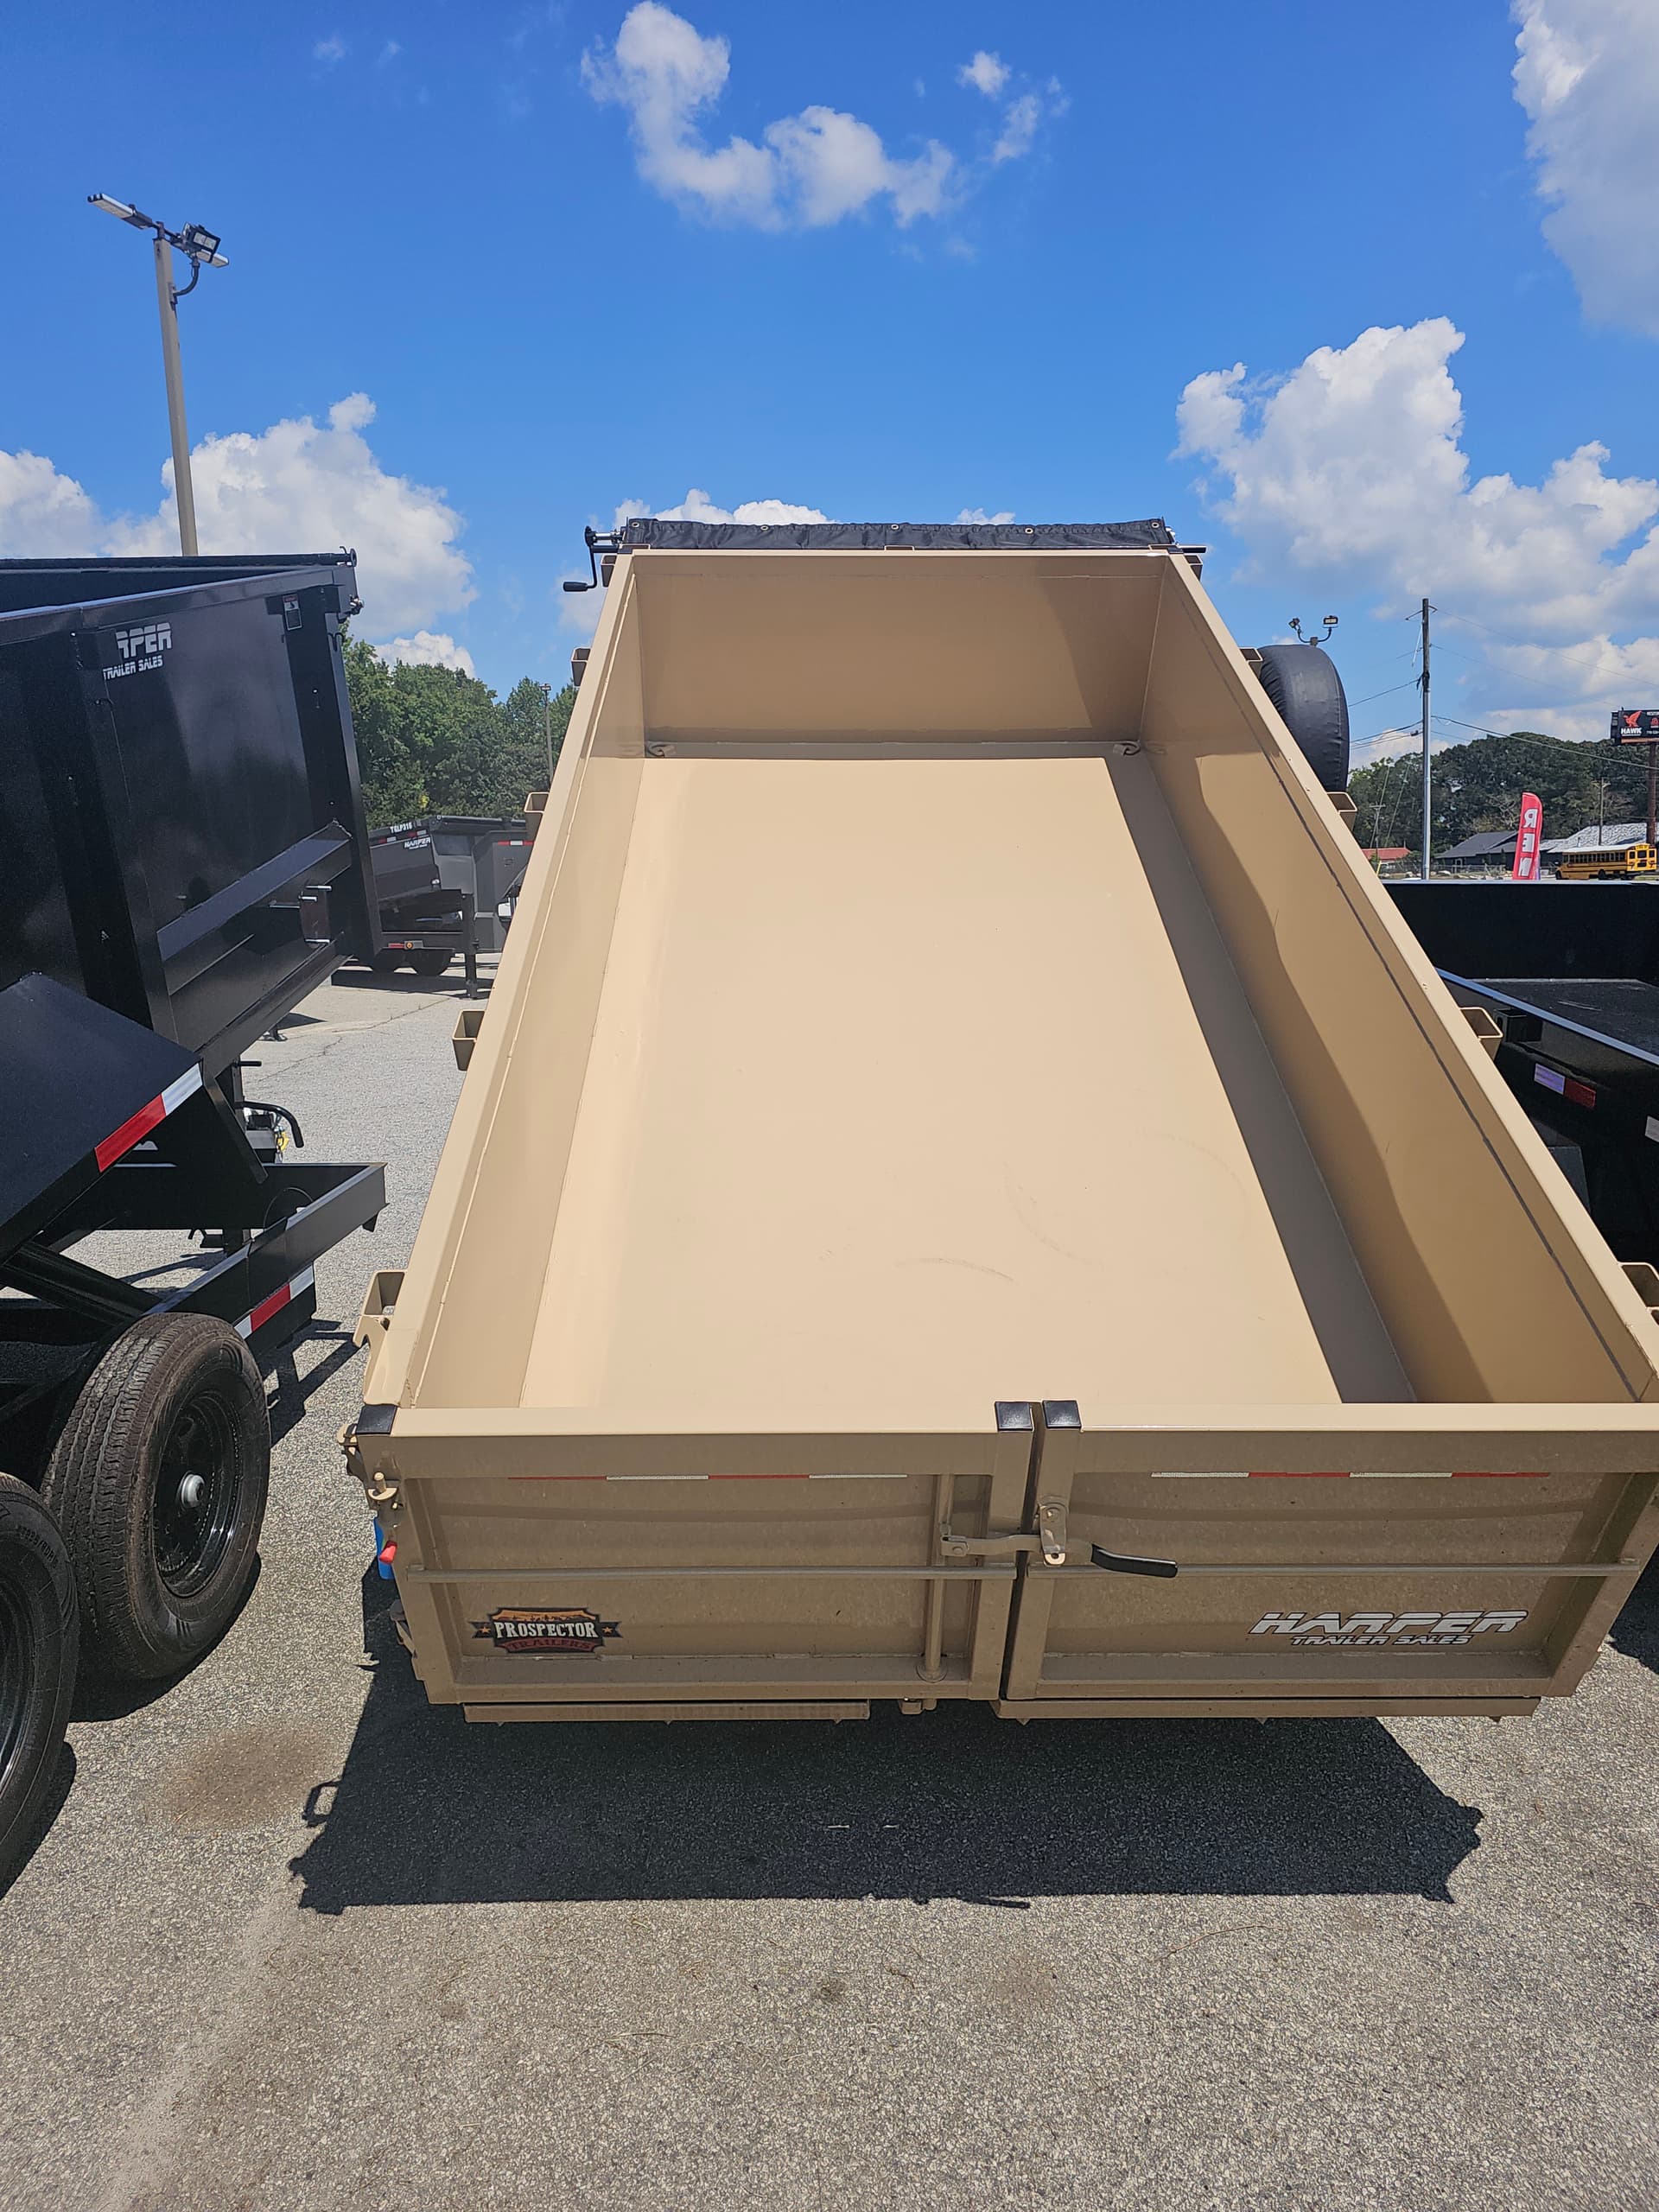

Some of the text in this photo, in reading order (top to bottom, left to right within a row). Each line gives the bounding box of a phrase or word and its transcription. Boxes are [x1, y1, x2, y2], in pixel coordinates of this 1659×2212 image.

[103, 655, 163, 680] TRAILER SALES
[404, 837, 431, 849] HARPER
[1249, 1610, 1529, 1634] HARPER
[493, 1622, 599, 1638] PROSPECTOR
[510, 1638, 591, 1650] TRAILERS
[1291, 1635, 1472, 1645] TRAILER SALES
